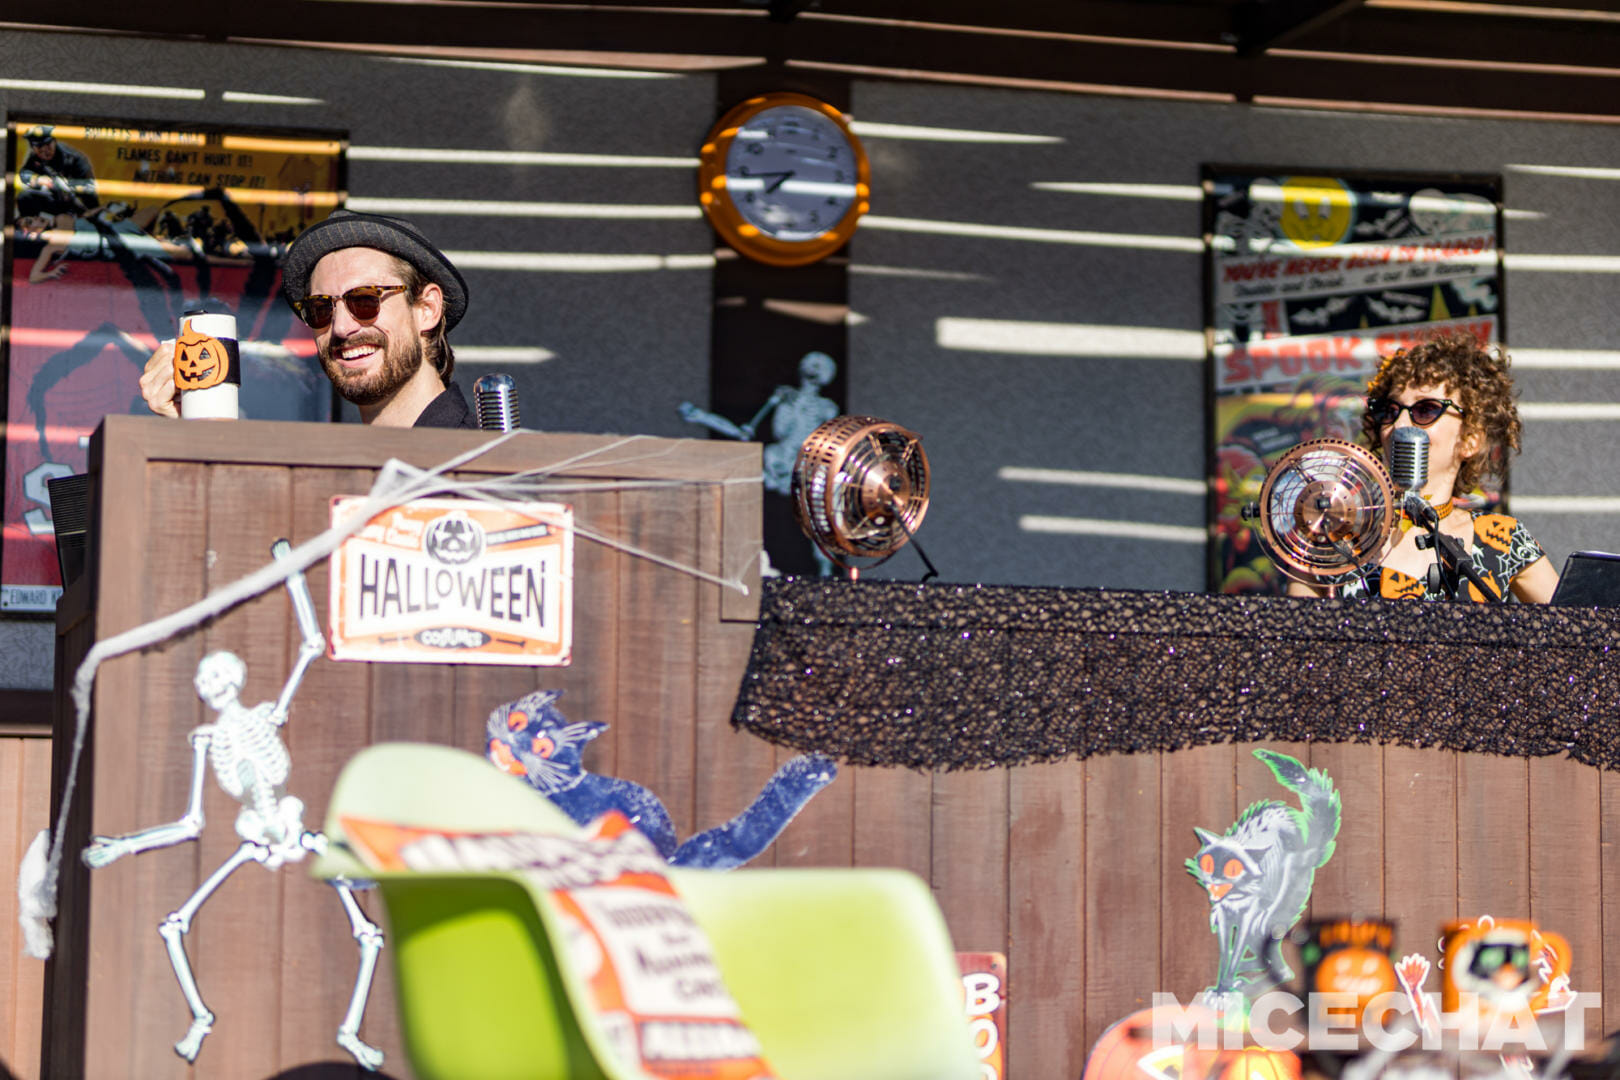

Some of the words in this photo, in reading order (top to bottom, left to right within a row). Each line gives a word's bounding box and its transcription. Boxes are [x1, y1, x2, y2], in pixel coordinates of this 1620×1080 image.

[117, 147, 161, 162] FLAMES
[165, 149, 198, 165] CAN'T
[203, 152, 233, 166] HURT
[188, 171, 211, 186] CAN
[217, 173, 244, 188] STOP
[1223, 335, 1364, 384] SPOOK
[360, 553, 546, 628] HALLOWEEN
